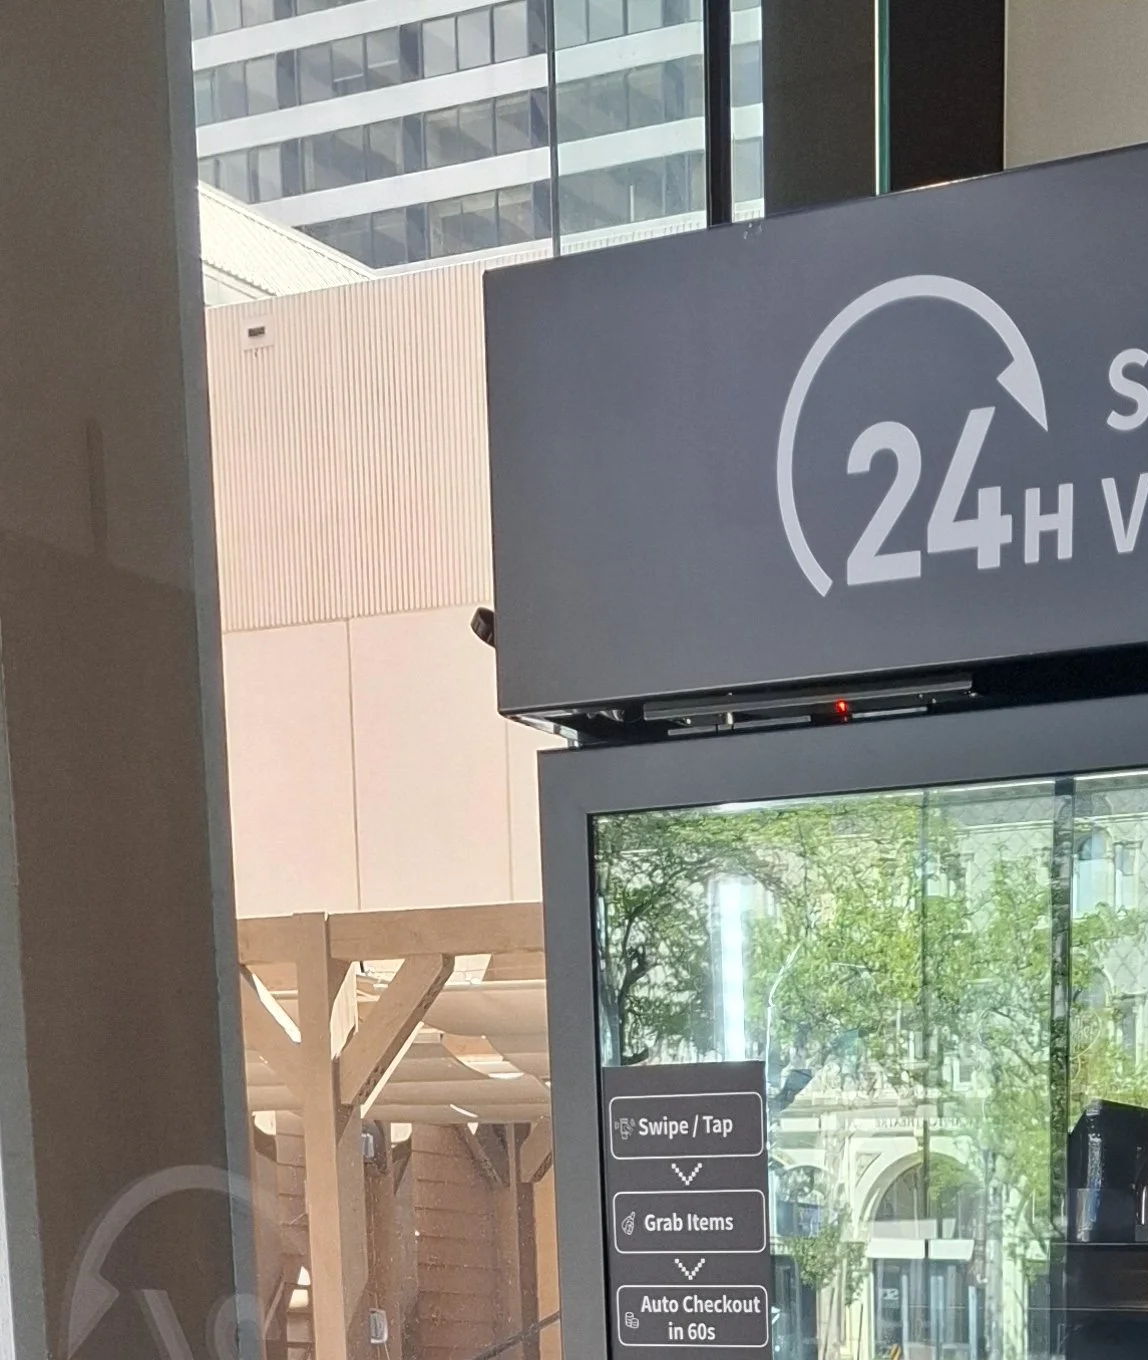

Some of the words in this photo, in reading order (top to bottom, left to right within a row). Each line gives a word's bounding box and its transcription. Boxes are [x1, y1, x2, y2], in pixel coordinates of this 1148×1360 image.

[638, 1116, 689, 1139] Swipe
[693, 1114, 698, 1138] /
[702, 1116, 733, 1138] Tap
[644, 1213, 683, 1231] Grab
[687, 1213, 734, 1231] Items
[641, 1296, 678, 1313] Auto
[683, 1295, 760, 1313] Checkout
[668, 1321, 683, 1340] in
[688, 1323, 716, 1340] 60s
